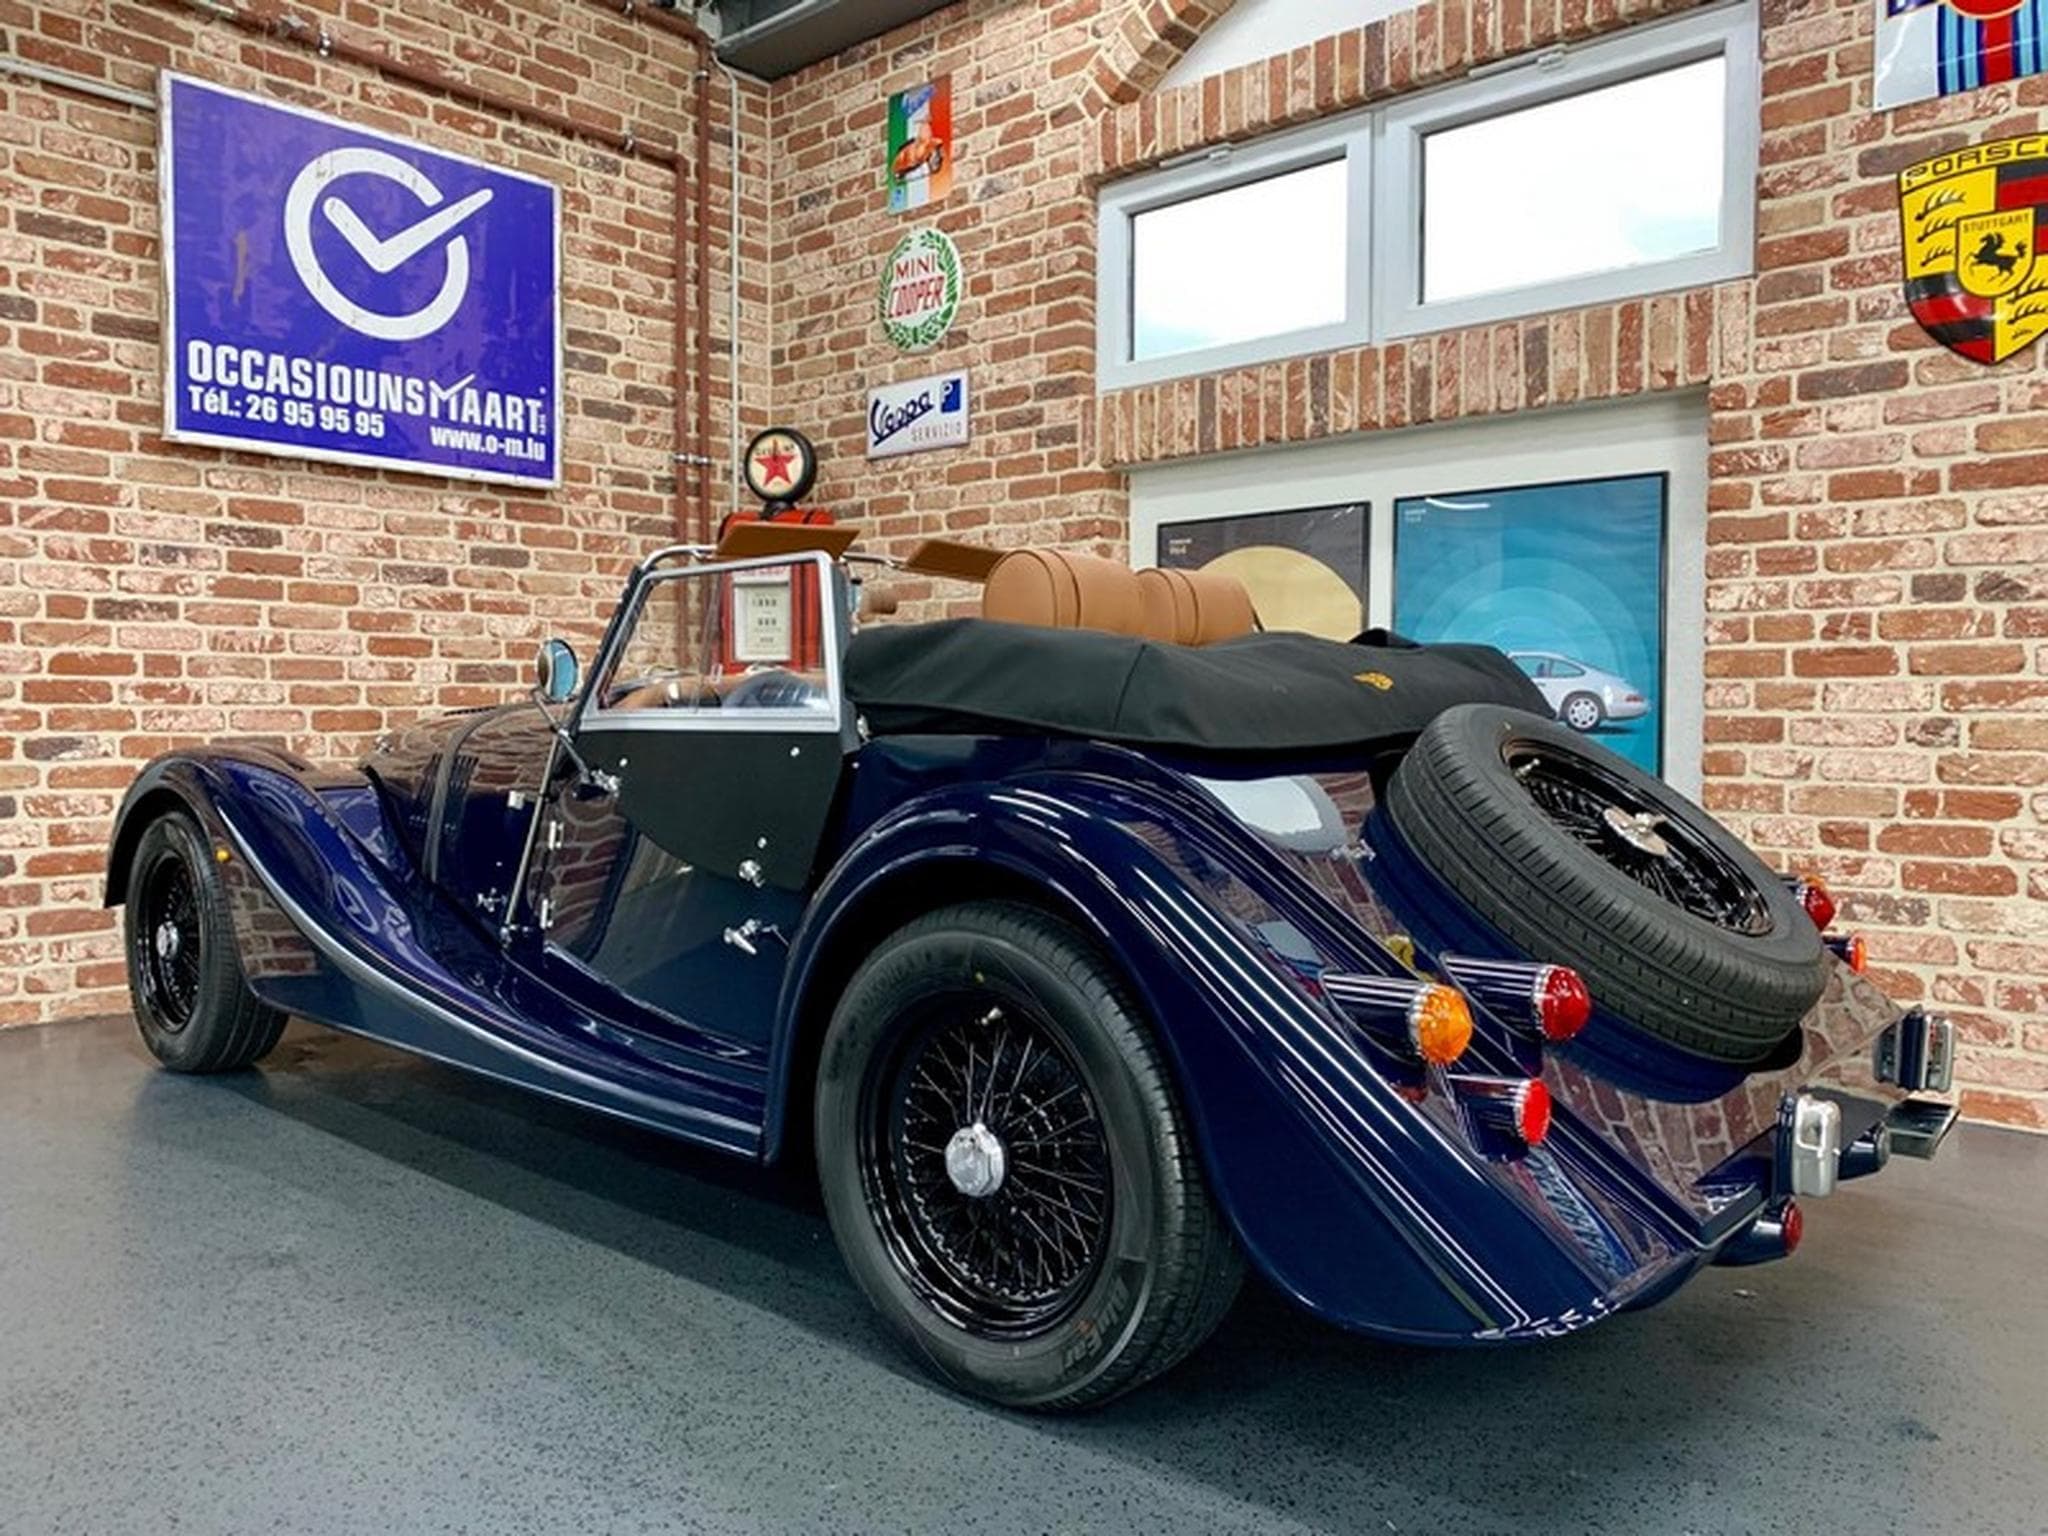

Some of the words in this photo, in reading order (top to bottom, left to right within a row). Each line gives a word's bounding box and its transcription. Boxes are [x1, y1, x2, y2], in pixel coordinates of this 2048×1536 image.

[1905, 136, 2048, 188] PORSC
[1962, 212, 2030, 234] STUTTGART
[895, 252, 936, 279] MINI
[887, 275, 945, 318] COOPER
[245, 393, 278, 422] 26
[282, 399, 315, 428] 95
[319, 405, 350, 433] 95
[355, 410, 386, 439] 95
[870, 390, 934, 447] Vespa
[430, 425, 547, 462] www.o-m.lu
